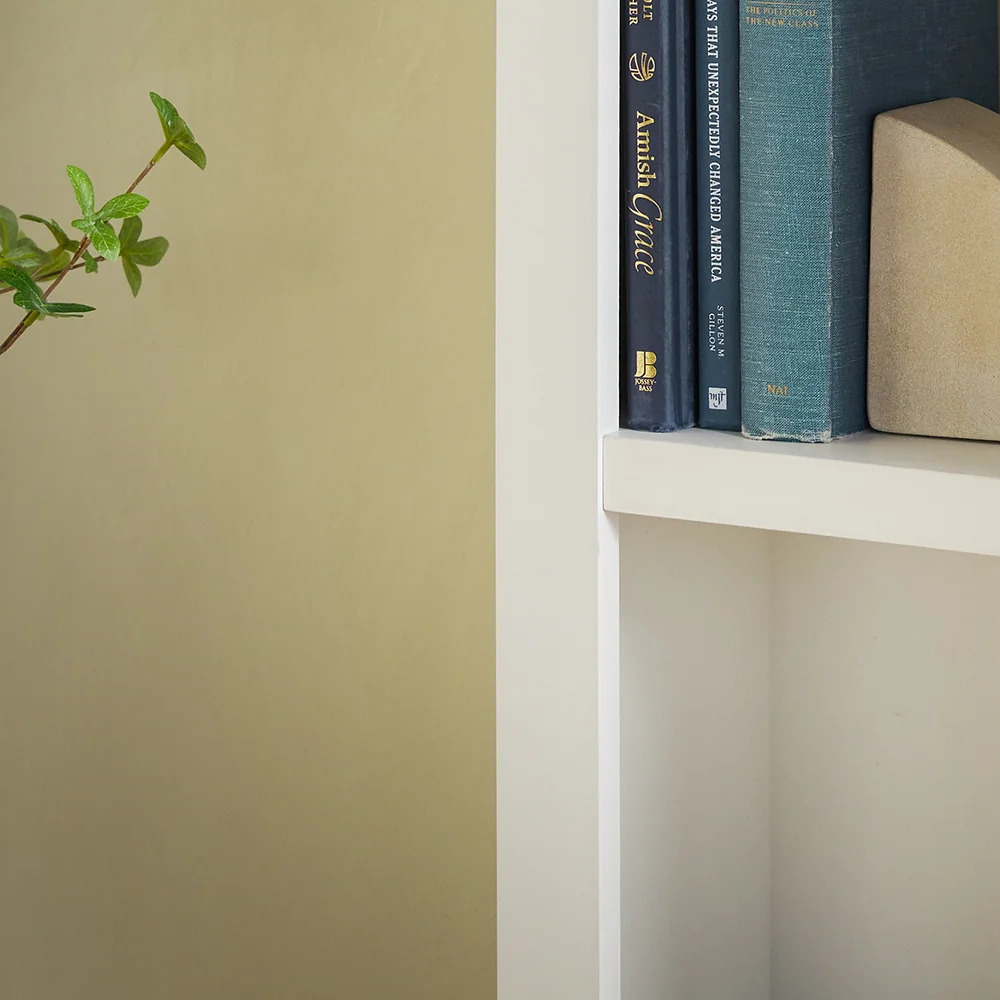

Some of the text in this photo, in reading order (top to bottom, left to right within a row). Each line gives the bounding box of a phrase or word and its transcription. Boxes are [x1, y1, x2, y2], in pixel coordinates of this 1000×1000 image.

[745, 6, 817, 17] THE POLITICS OF
[745, 17, 819, 28] THE NEW CLASS
[706, 25, 719, 58] THAT
[707, 63, 721, 158] UNEXPECTEDLY
[636, 111, 657, 188] Amish
[709, 162, 722, 222] CHANGED
[628, 193, 663, 275] Grace
[710, 225, 723, 283] AMERICA
[708, 313, 716, 352] GILLON
[716, 305, 725, 344] STEVEN
[767, 384, 790, 396] NAL
